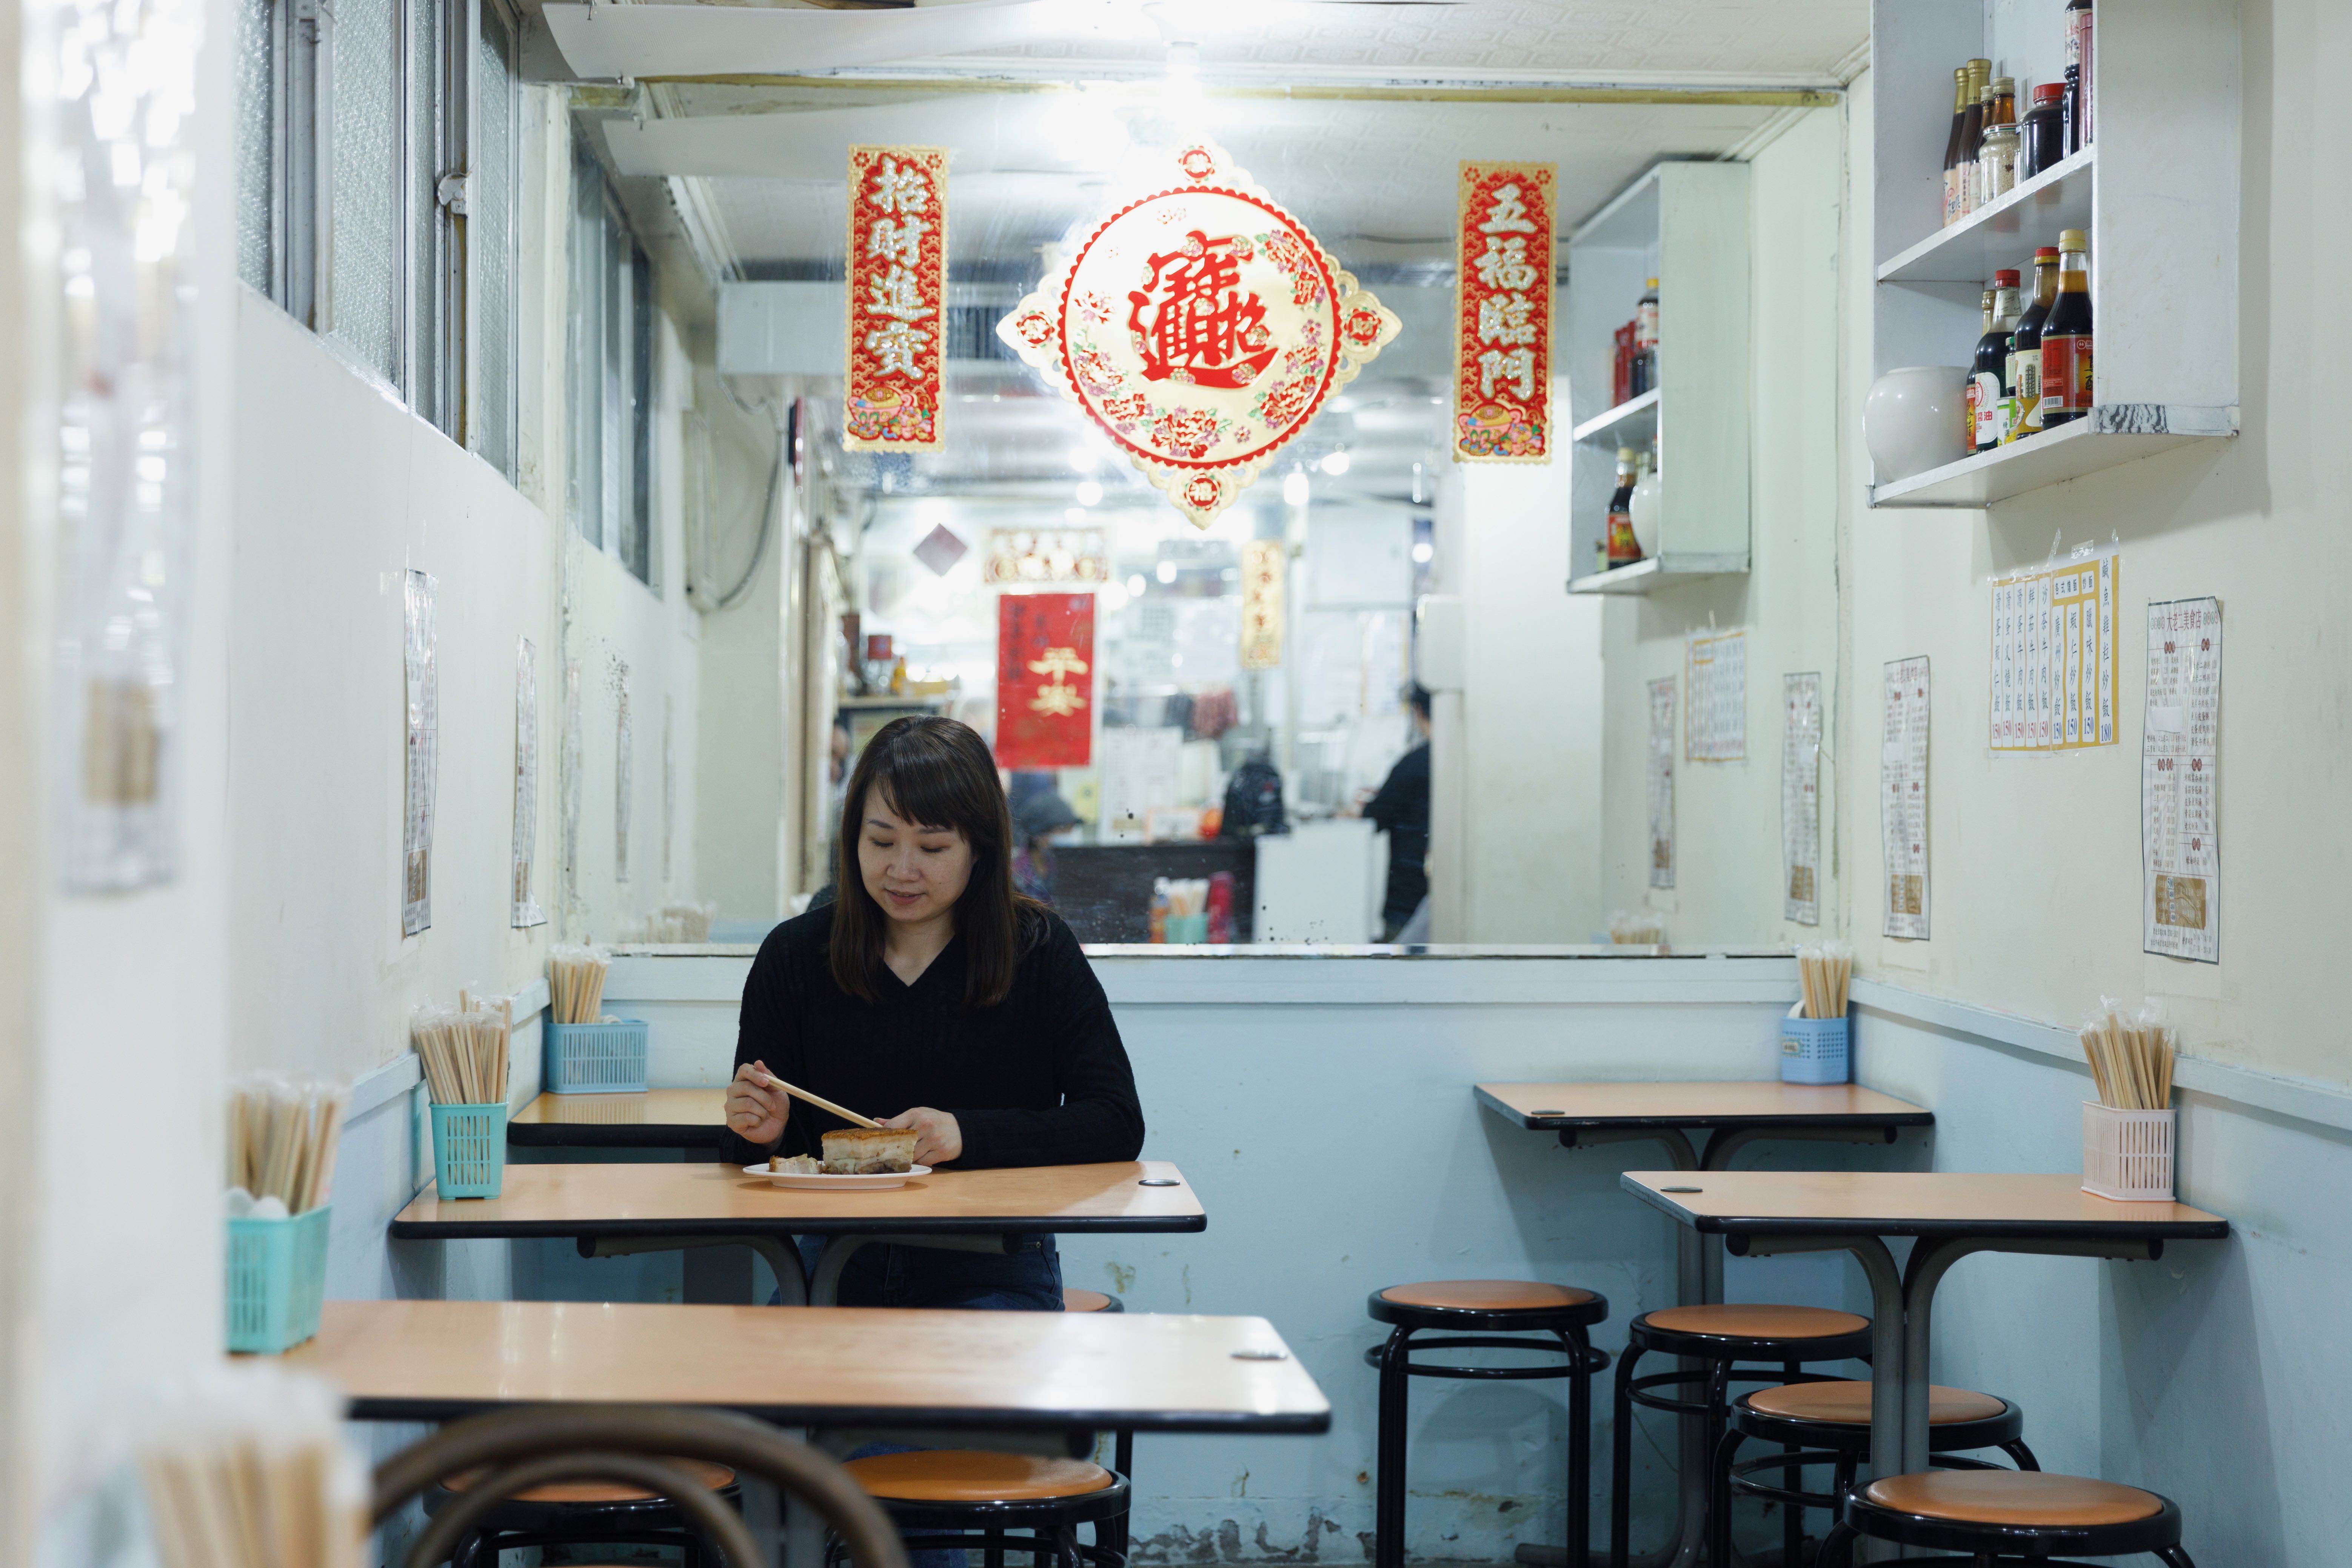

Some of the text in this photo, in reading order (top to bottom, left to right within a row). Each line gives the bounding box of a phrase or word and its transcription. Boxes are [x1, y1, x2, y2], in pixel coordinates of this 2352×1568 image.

[864, 155, 937, 380] 招財進寶
[1472, 183, 1539, 401] 五福臨門
[2166, 608, 2201, 632] 大老二美食店
[2003, 720, 2012, 736] 150
[2015, 722, 2024, 739] 150
[2027, 722, 2036, 739] 150
[2039, 720, 2049, 739] 150
[2053, 722, 2062, 739] 150
[2067, 718, 2078, 736] 150
[2084, 717, 2094, 734] 150
[2101, 723, 2112, 742] 180
